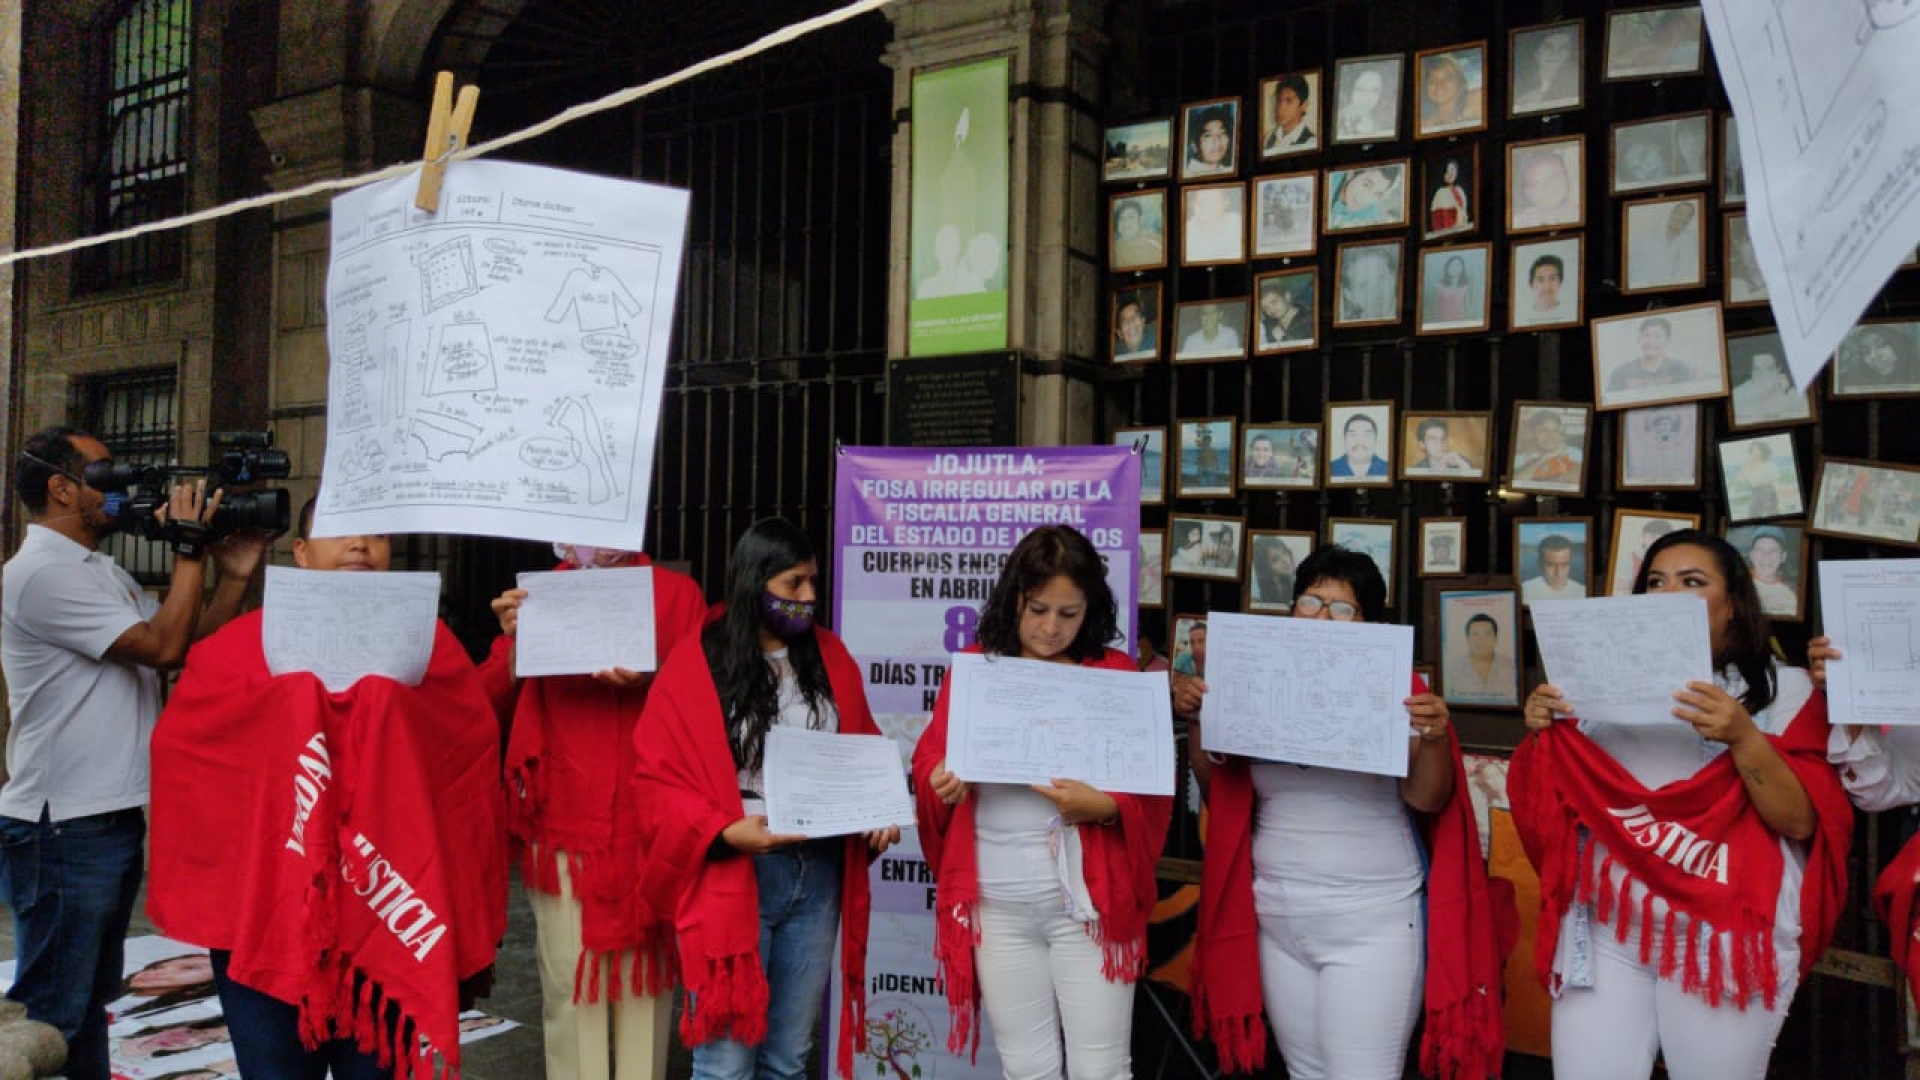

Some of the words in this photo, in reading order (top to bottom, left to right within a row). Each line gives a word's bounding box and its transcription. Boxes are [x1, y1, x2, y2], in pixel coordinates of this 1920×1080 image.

[926, 453, 1045, 476] JOJUTLA:
[863, 479, 917, 500] FOSA
[922, 479, 1045, 500] IRREGULAR
[1051, 481, 1080, 500] DE
[1085, 480, 1113, 500] LA
[885, 497, 982, 523] FISCALÍA
[985, 503, 1086, 524] GENERAL
[851, 524, 889, 545] DEL
[894, 525, 977, 546] ESTADO
[981, 526, 1010, 547] DE
[862, 551, 953, 575] CUERPOS
[910, 577, 934, 600] EN
[869, 657, 916, 686] DÍAS
[921, 664, 947, 688] TR
[1607, 803, 1729, 885] JUSTICIA
[881, 858, 937, 884] ENTR
